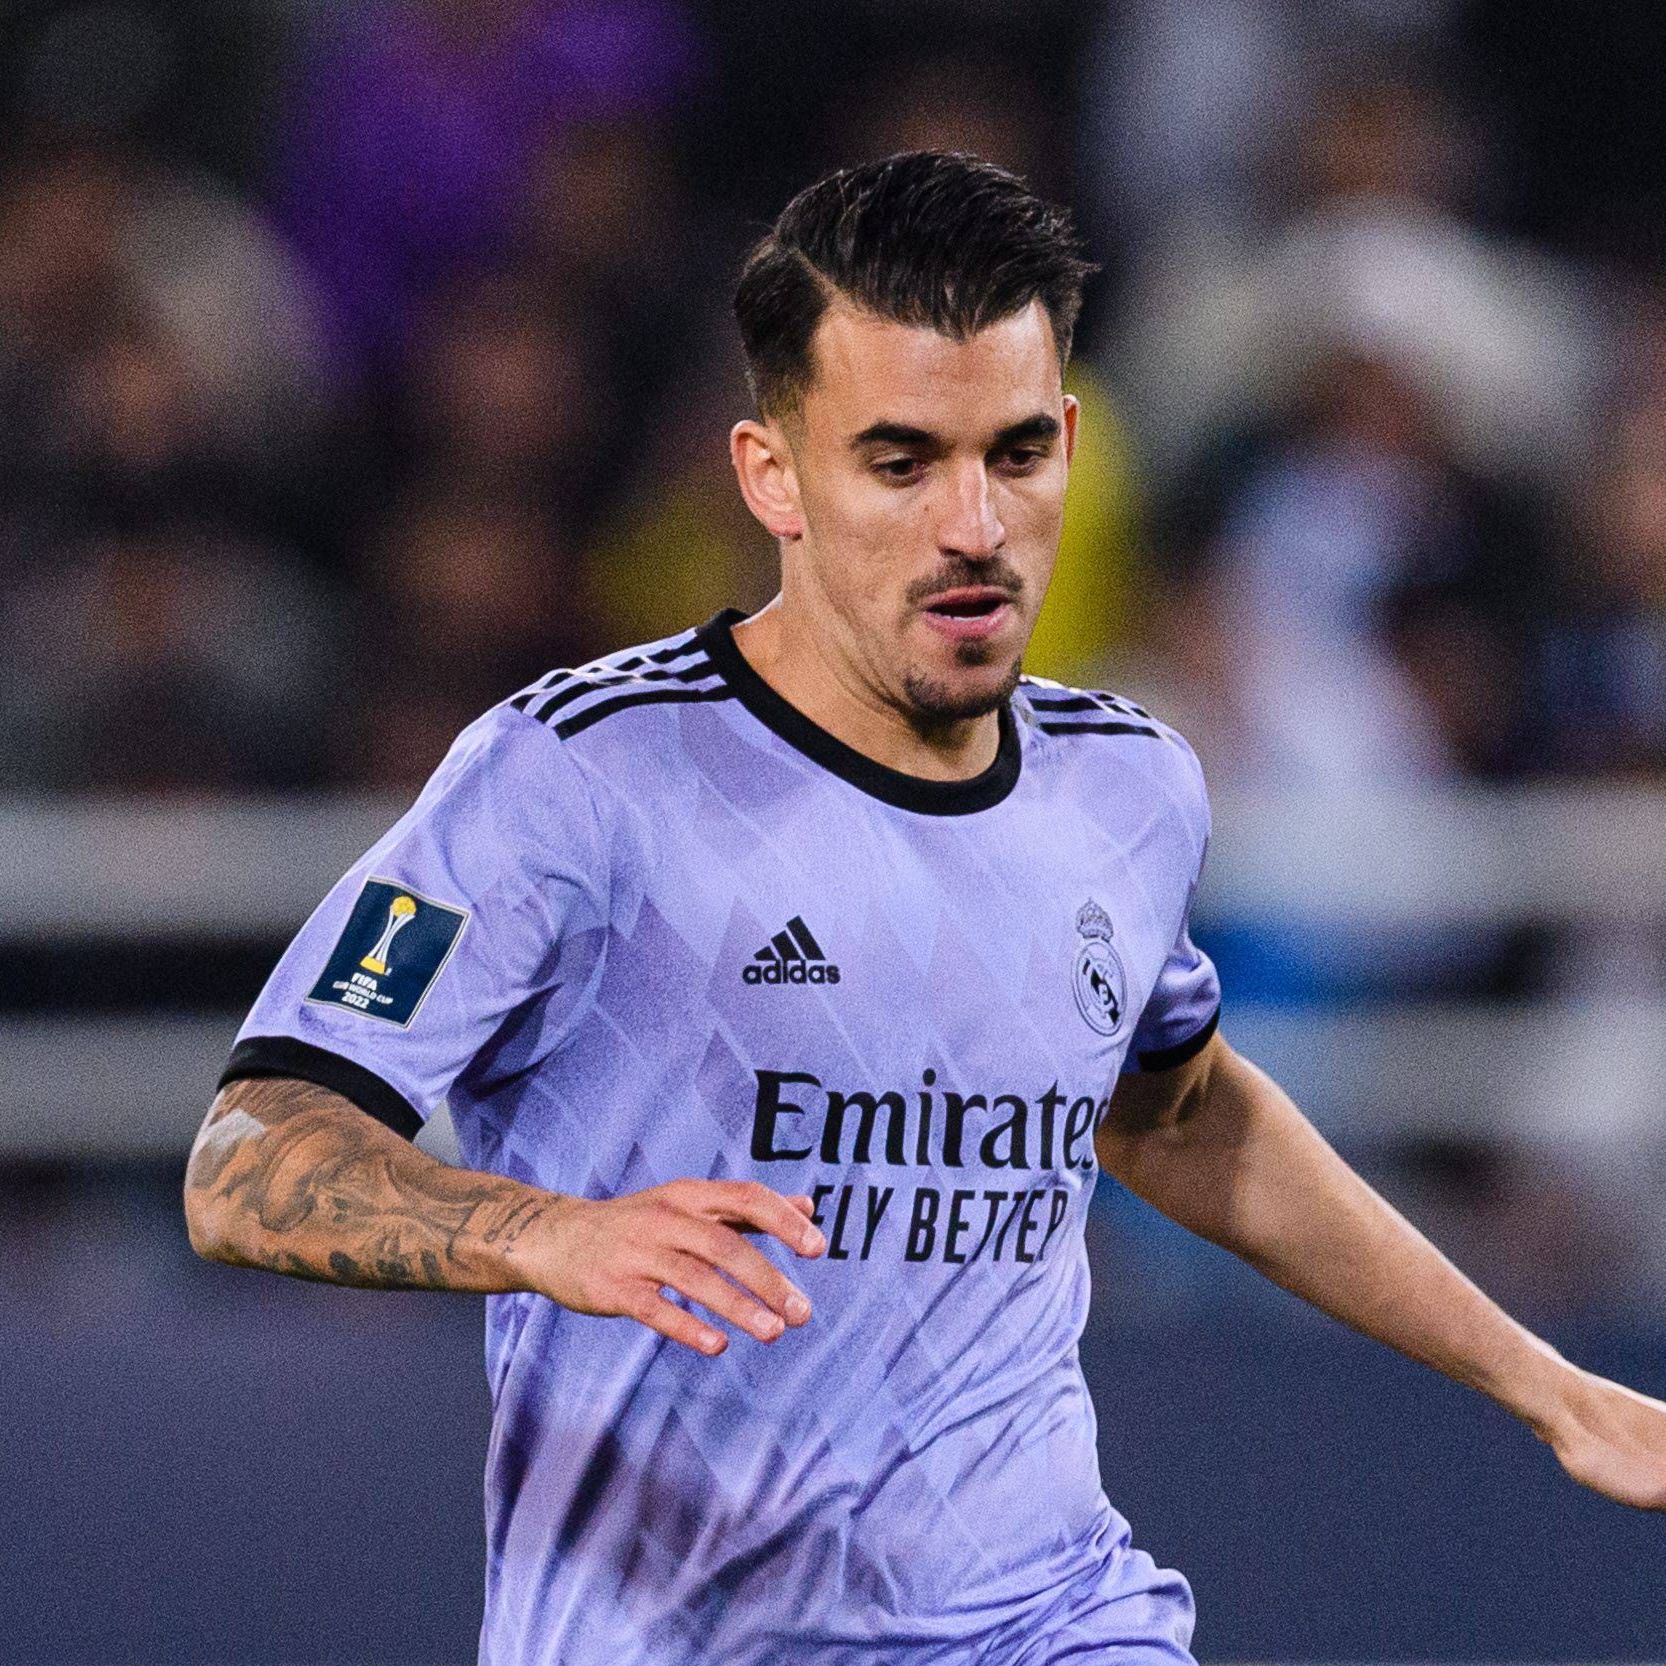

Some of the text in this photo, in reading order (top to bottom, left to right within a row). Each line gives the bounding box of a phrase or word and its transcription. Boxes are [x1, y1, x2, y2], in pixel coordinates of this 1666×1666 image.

[742, 959, 841, 985] adidas
[352, 973, 377, 991] FIFA
[342, 991, 370, 1009] 2022
[377, 995, 393, 1004] CUP
